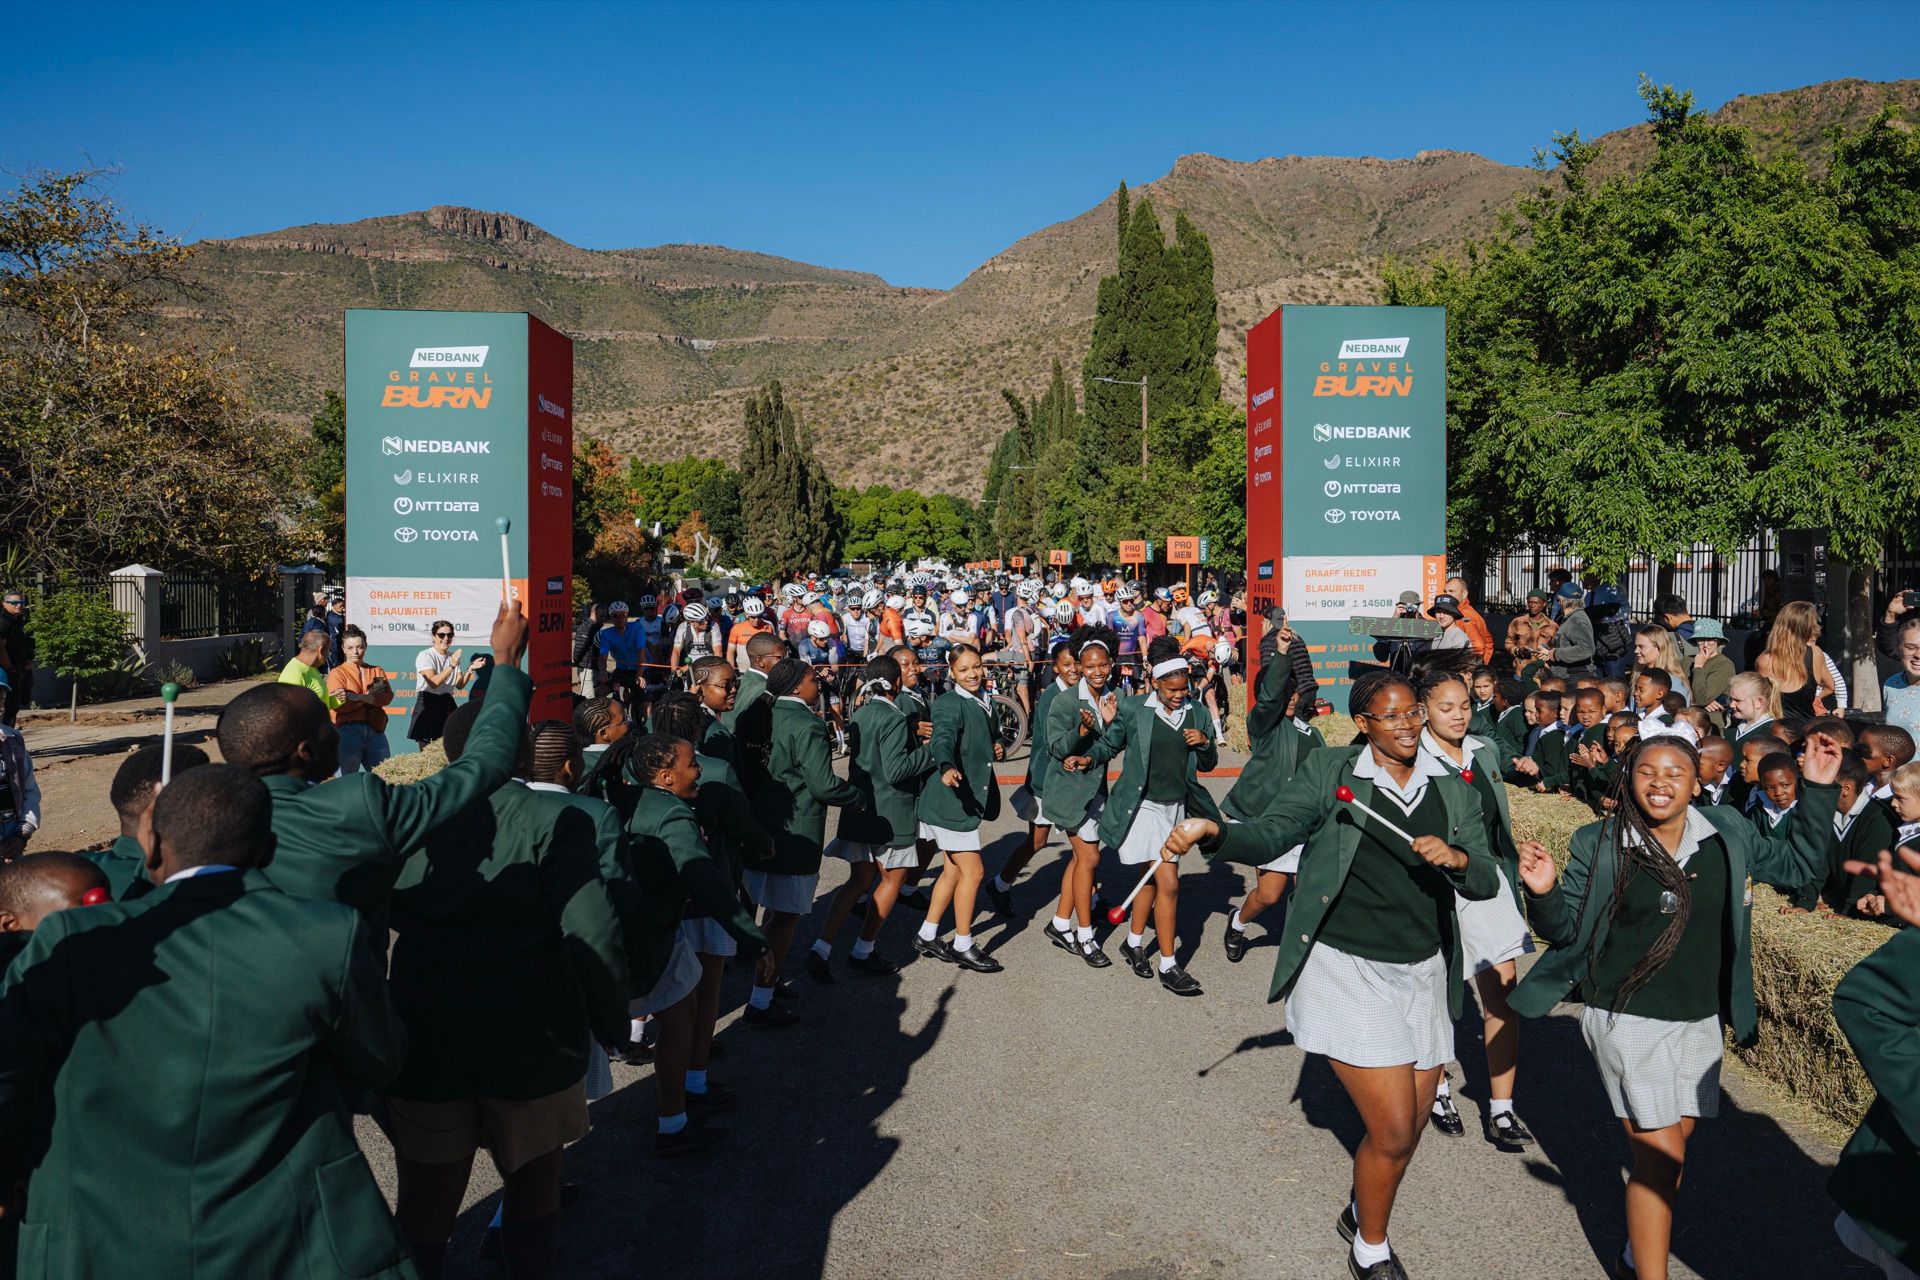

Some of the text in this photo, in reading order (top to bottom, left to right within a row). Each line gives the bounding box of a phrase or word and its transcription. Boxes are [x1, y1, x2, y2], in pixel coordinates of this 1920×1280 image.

[1345, 344, 1402, 353] NEDBANK
[417, 352, 481, 362] NEDBANK
[1320, 362, 1413, 372] GRAVEL
[389, 370, 493, 384] GRAVEL
[1312, 375, 1413, 397] BURN
[381, 385, 493, 409] BURN
[1333, 426, 1411, 439] NEDBANK
[404, 439, 491, 454] NEDBANK
[1345, 457, 1401, 467] ELIXIRR
[417, 472, 479, 483] ELIXIRR
[1343, 483, 1368, 494] NTT
[415, 501, 443, 511] NTT
[1349, 510, 1401, 521] TOYOTA
[422, 530, 479, 542] TOYOTA
[1174, 541, 1192, 549] PRO
[1053, 552, 1063, 563] A
[1174, 551, 1192, 559] MEN
[1015, 558, 1021, 566] B
[1305, 569, 1378, 578] GRAAFF REINET
[1305, 584, 1365, 593] BLAAUWATER
[1427, 562, 1437, 608] TAGE 3
[369, 591, 453, 600] GRAAFF REINET
[1321, 599, 1393, 608] 90KM 1450M
[370, 606, 438, 616] BLAAUWATER
[388, 622, 416, 632] 90KM
[539, 612, 566, 634] BURN
[1325, 661, 1350, 669] SOUT
